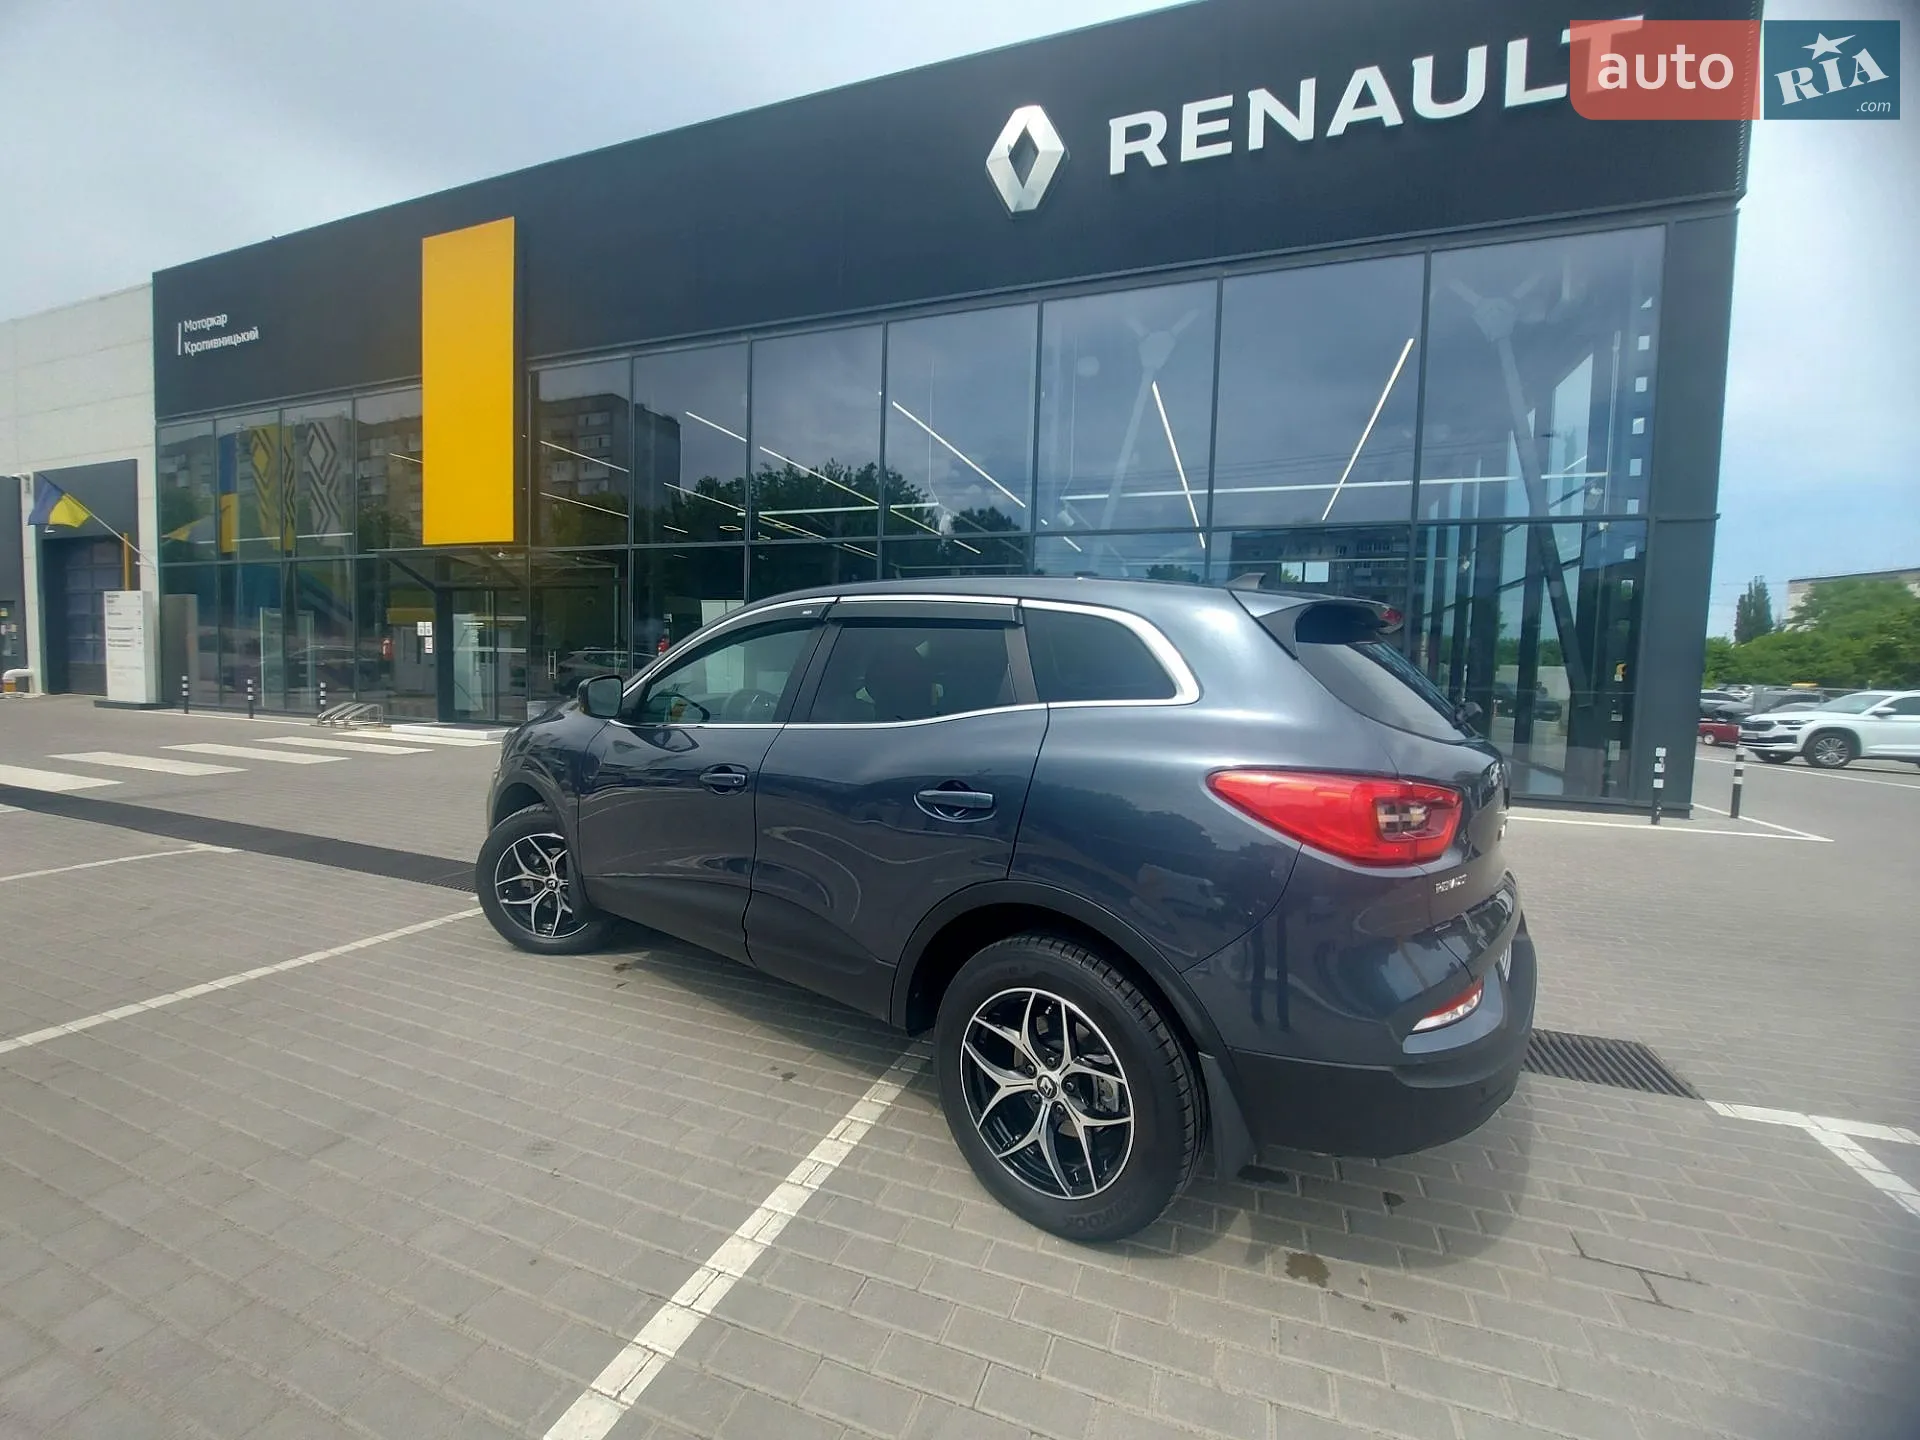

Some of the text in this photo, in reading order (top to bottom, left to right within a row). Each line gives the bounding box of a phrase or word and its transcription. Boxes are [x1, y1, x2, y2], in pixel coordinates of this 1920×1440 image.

[1109, 15, 1644, 176] RENAULT
[184, 313, 228, 332] Моторкар
[184, 326, 259, 356] Кропивницький
